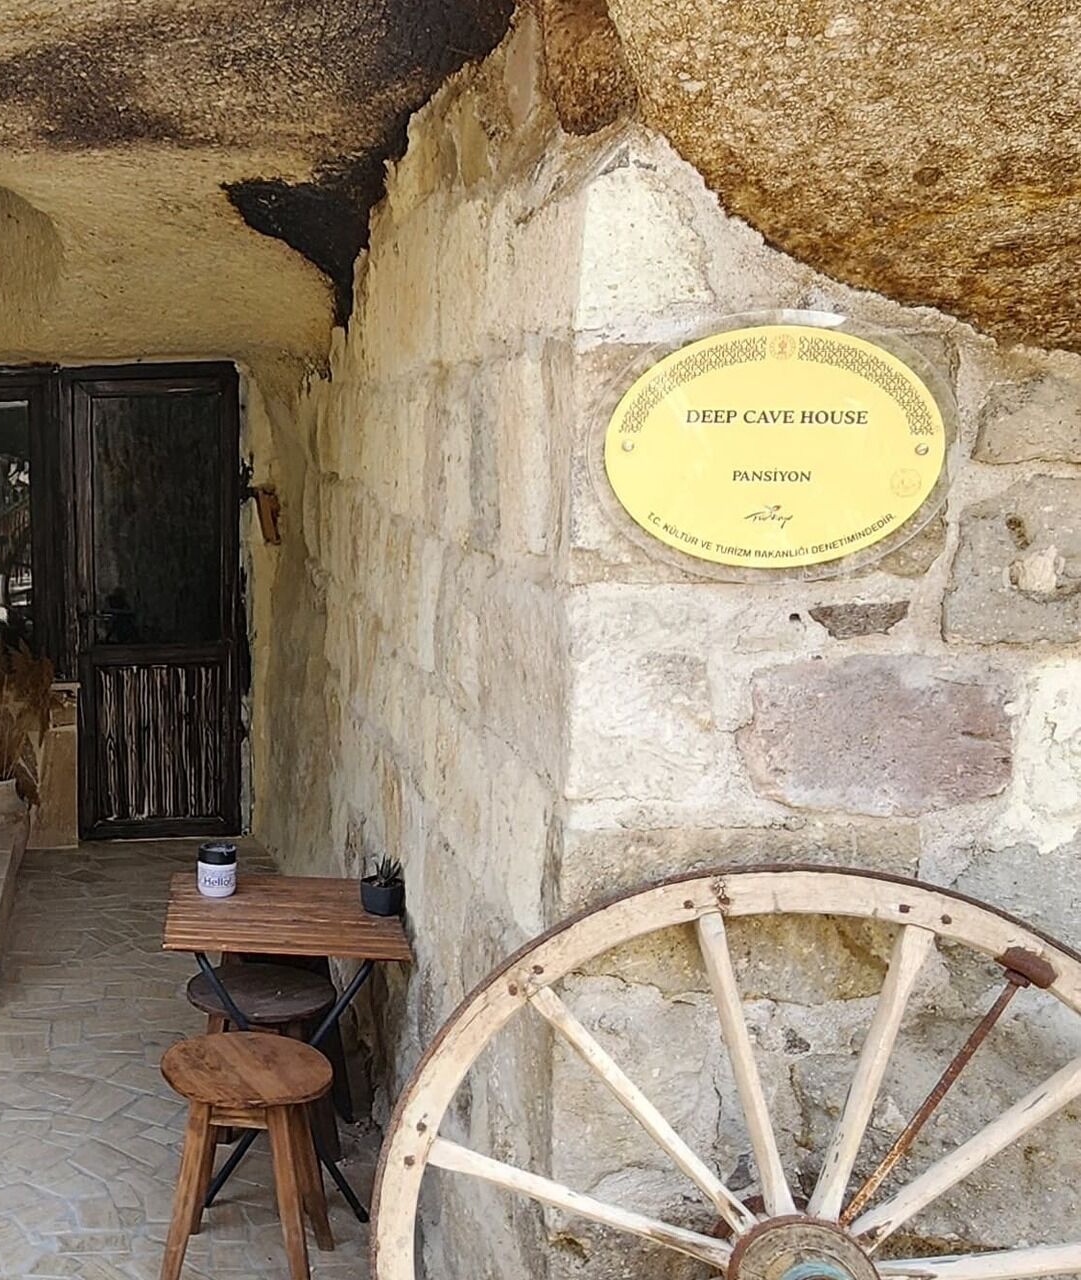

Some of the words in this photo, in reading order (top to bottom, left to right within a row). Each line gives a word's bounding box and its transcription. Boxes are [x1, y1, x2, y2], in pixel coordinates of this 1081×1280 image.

[686, 409, 737, 424] DEEP
[743, 409, 795, 424] CAVE
[800, 410, 869, 425] HOUSE
[732, 468, 812, 483] PANSİYON
[662, 523, 699, 546] KÜLTÜR
[701, 540, 713, 550] VE
[715, 544, 752, 558] TURİZM
